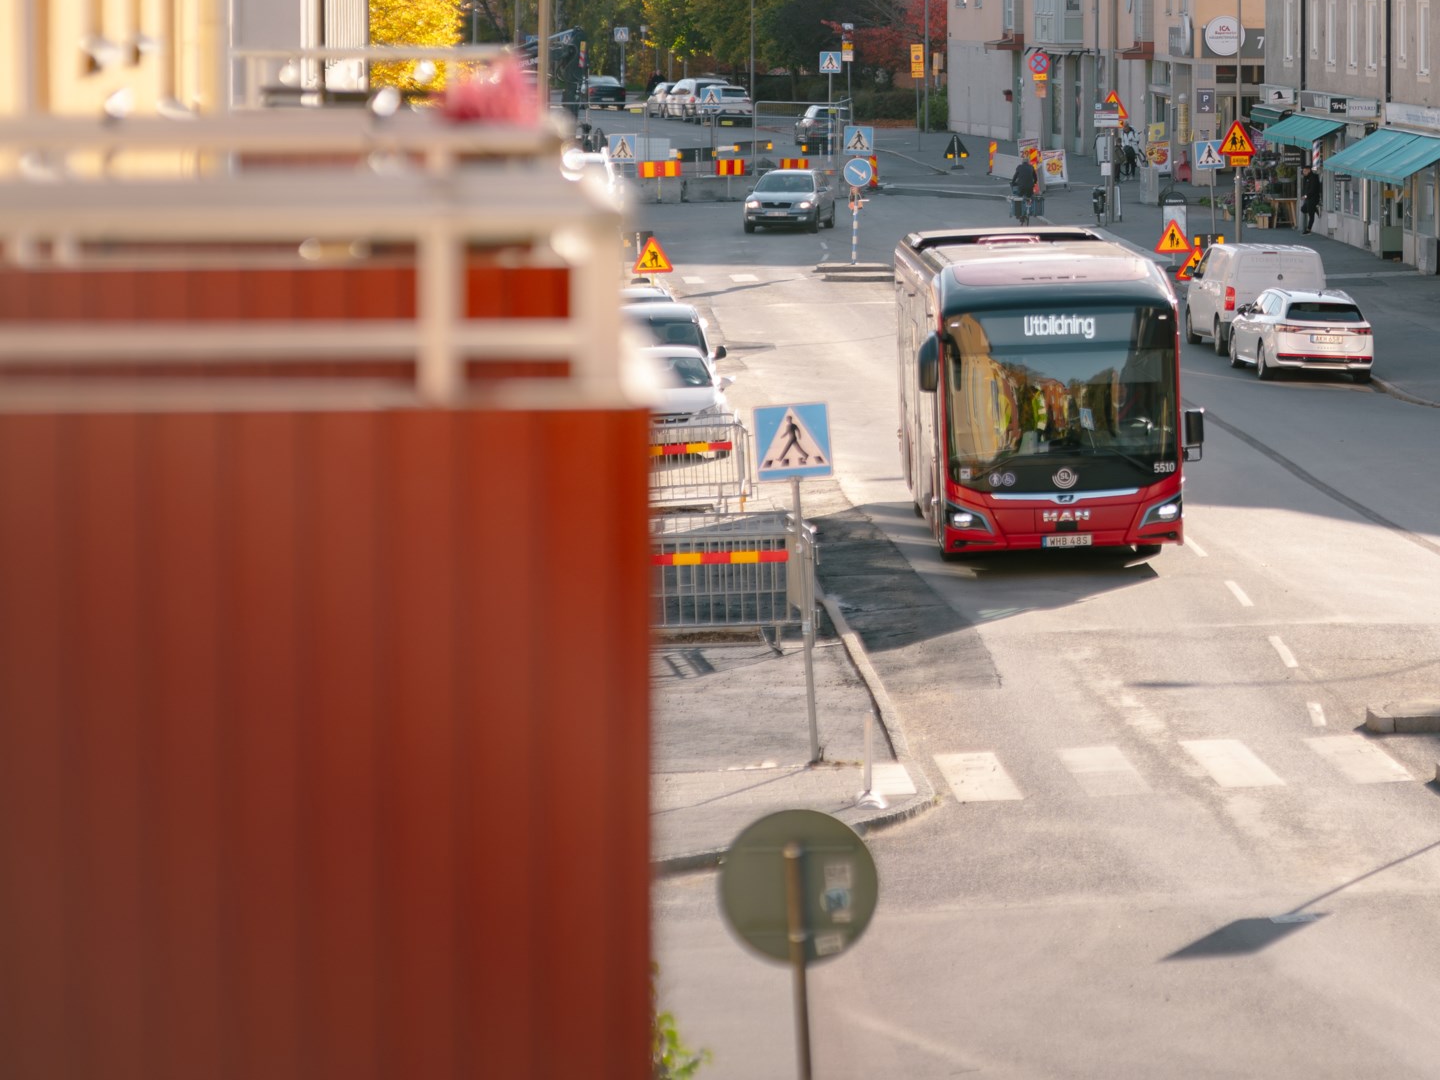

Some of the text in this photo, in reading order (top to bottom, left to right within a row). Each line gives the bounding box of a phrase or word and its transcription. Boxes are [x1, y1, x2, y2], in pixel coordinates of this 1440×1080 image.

[1024, 315, 1095, 339] Utbildning
[1153, 462, 1175, 474] 5510
[1060, 472, 1069, 480] SL
[1043, 511, 1090, 522] MAN
[1050, 537, 1069, 546] WHB
